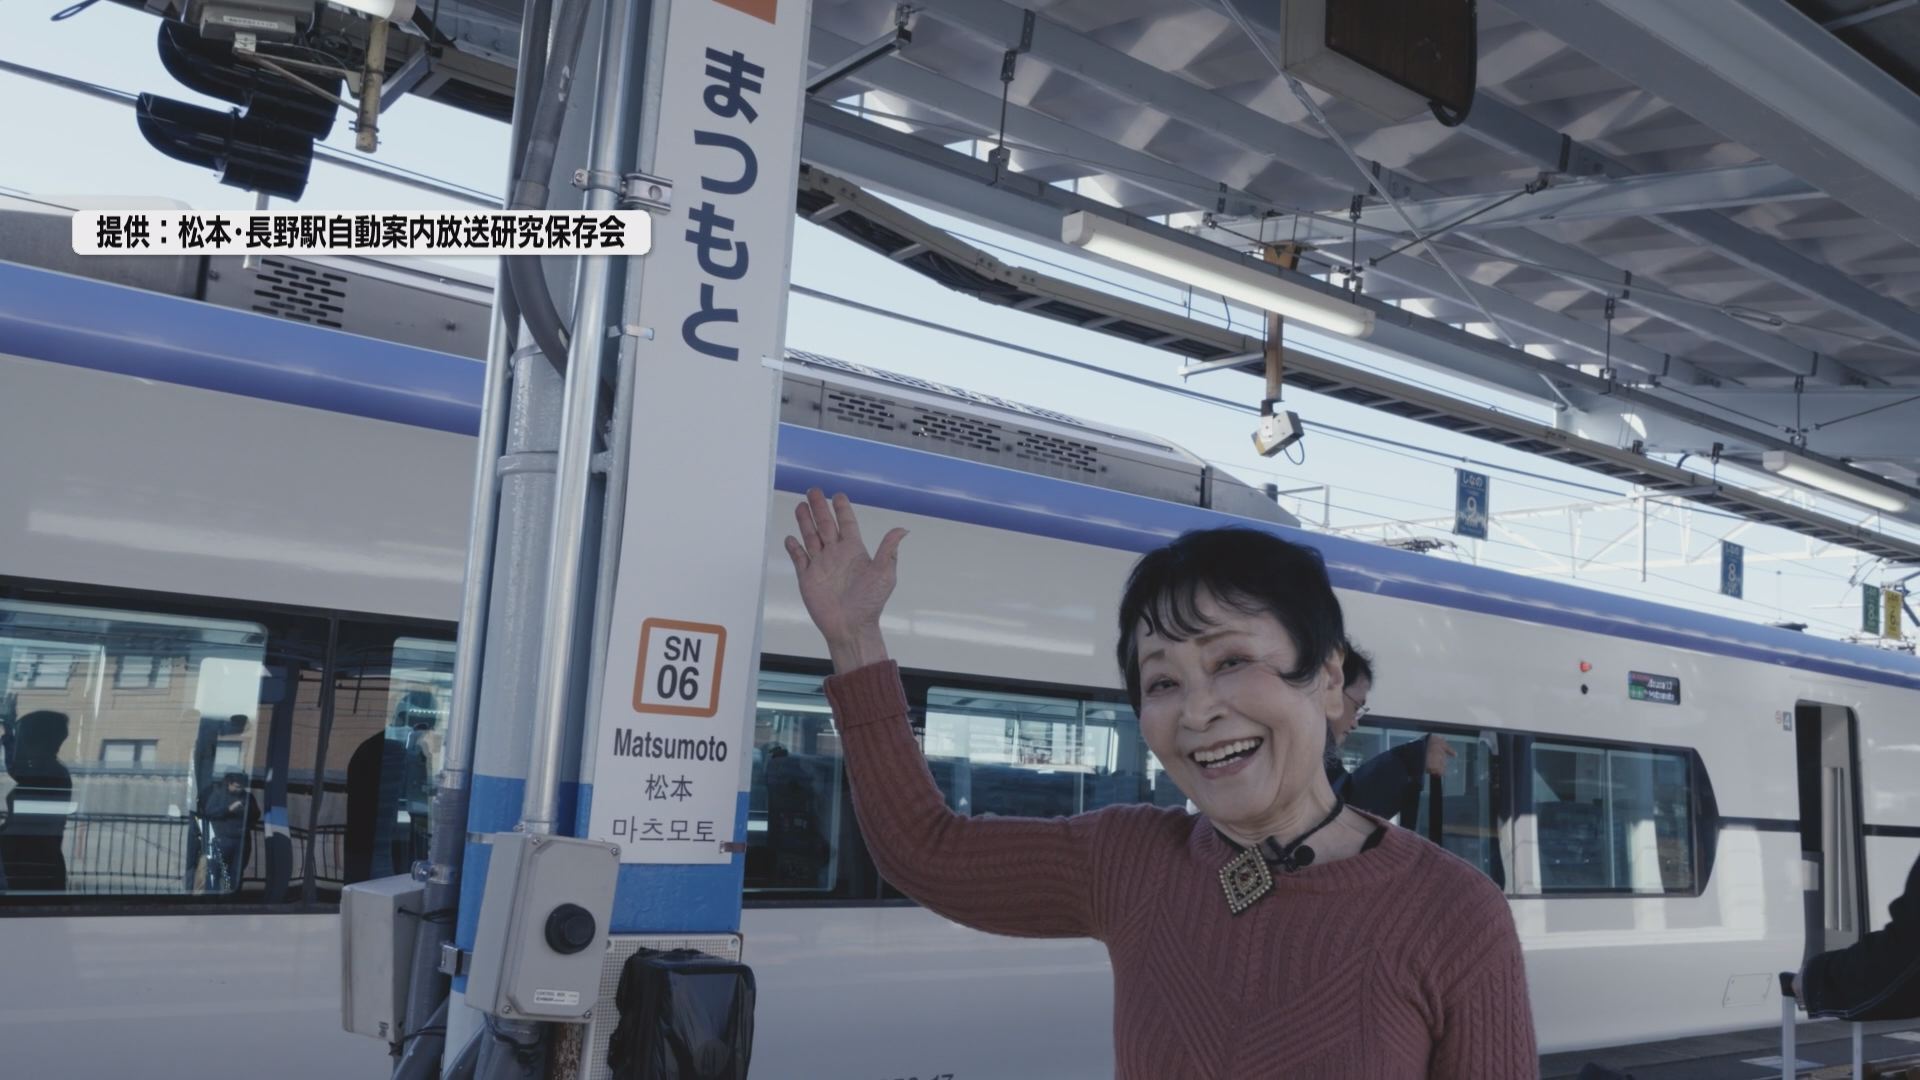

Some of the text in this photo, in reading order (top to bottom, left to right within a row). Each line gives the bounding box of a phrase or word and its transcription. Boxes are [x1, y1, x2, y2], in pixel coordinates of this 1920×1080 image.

[682, 47, 765, 362] まつもと
[663, 635, 702, 663] SN
[656, 664, 700, 701] 06
[613, 727, 728, 763] Matsumoto
[644, 773, 693, 802] 松本
[612, 815, 716, 844] 마츠모토
